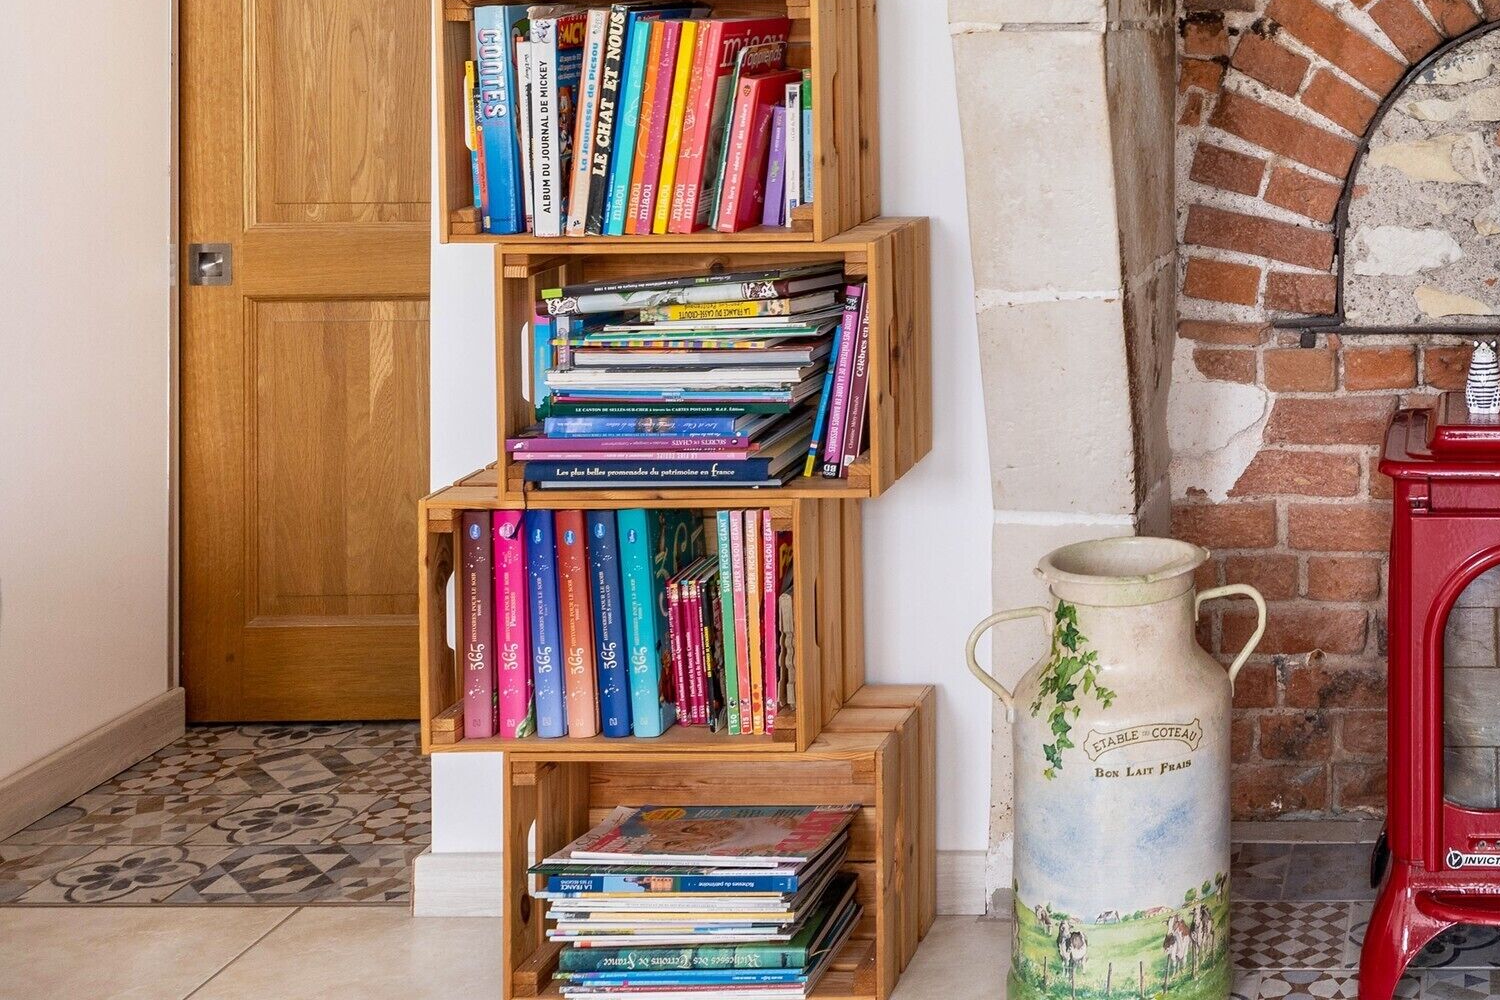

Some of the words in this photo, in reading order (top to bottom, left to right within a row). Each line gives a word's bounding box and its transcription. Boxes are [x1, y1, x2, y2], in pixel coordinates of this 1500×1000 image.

[606, 11, 624, 61] NOUS
[478, 28, 507, 119] CONTES
[588, 42, 599, 81] Picsou
[539, 60, 548, 98] MICKEY
[586, 84, 595, 98] de
[603, 66, 619, 91] ET
[540, 100, 548, 114] DE
[580, 102, 593, 156] Jeunesse
[596, 98, 614, 148] CHAT
[540, 116, 550, 161] JOURNAL
[542, 164, 550, 177] DU
[580, 158, 588, 172] La
[592, 153, 608, 177] LE
[542, 180, 551, 214] ALBUM
[612, 185, 624, 220] miaou
[630, 183, 641, 218] miaou
[640, 184, 652, 220] miaou
[658, 184, 670, 219] miaou
[673, 184, 684, 220] miaou
[684, 184, 696, 219] miaou
[844, 314, 853, 330] GUIDE
[842, 331, 851, 341] DES
[856, 340, 867, 377] Célèbres
[862, 327, 868, 338] en
[836, 383, 844, 397] LOIRE
[832, 406, 841, 426] BANDES
[556, 468, 568, 476] Les
[570, 468, 585, 477] plus
[586, 468, 605, 476] belles
[608, 468, 648, 477] promenades
[650, 468, 659, 476] du
[661, 468, 699, 477] patrimoine
[468, 644, 484, 671] 365
[502, 643, 518, 670] 365
[535, 646, 552, 674] 365
[568, 648, 584, 675] 365
[601, 642, 617, 669] 365
[631, 647, 648, 674] 365
[1092, 730, 1140, 752] ETABLE
[1151, 727, 1197, 741] COTEAU
[603, 952, 636, 970] France
[639, 958, 648, 968] de
[651, 955, 691, 970] Terroirs
[693, 956, 708, 968] des
